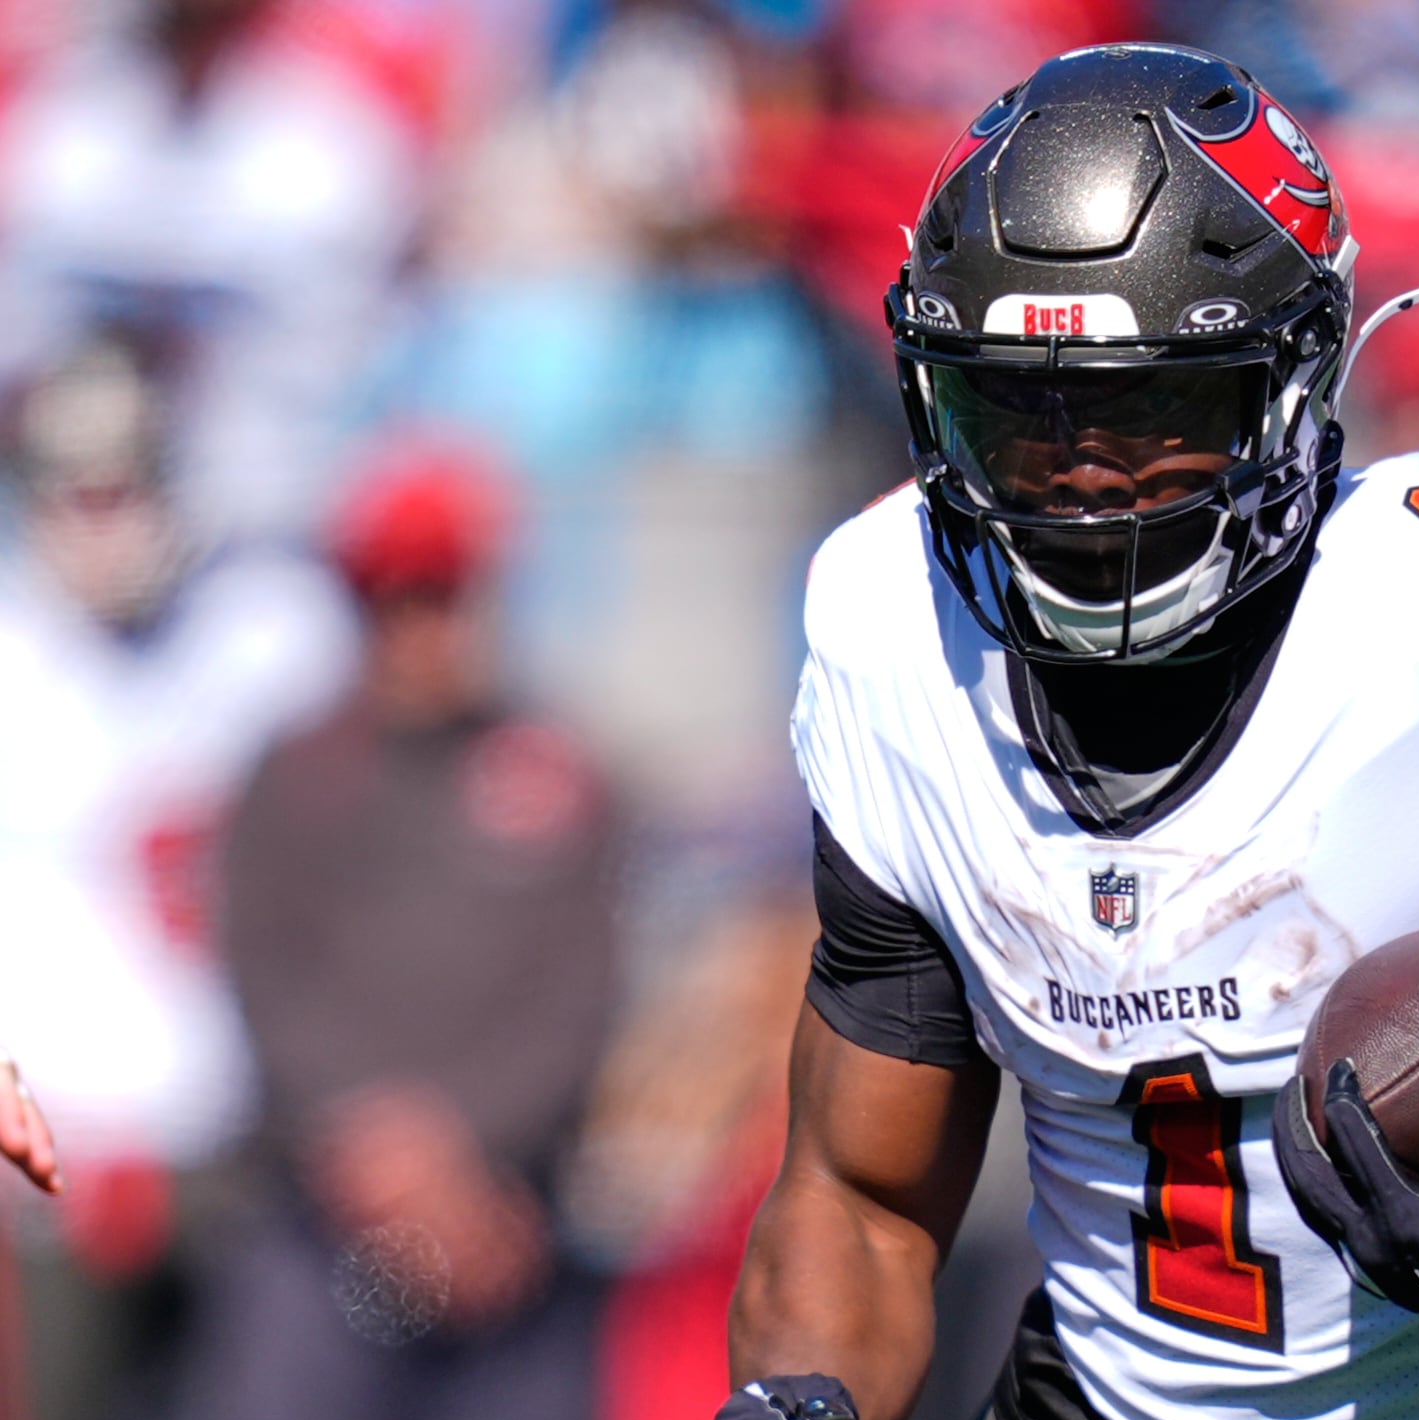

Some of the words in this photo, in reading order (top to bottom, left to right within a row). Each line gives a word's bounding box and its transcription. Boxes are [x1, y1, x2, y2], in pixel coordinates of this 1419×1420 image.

[1095, 893, 1133, 925] NFL
[1043, 975, 1241, 1044] BUCCANEERS
[1114, 1051, 1287, 1357] 1
